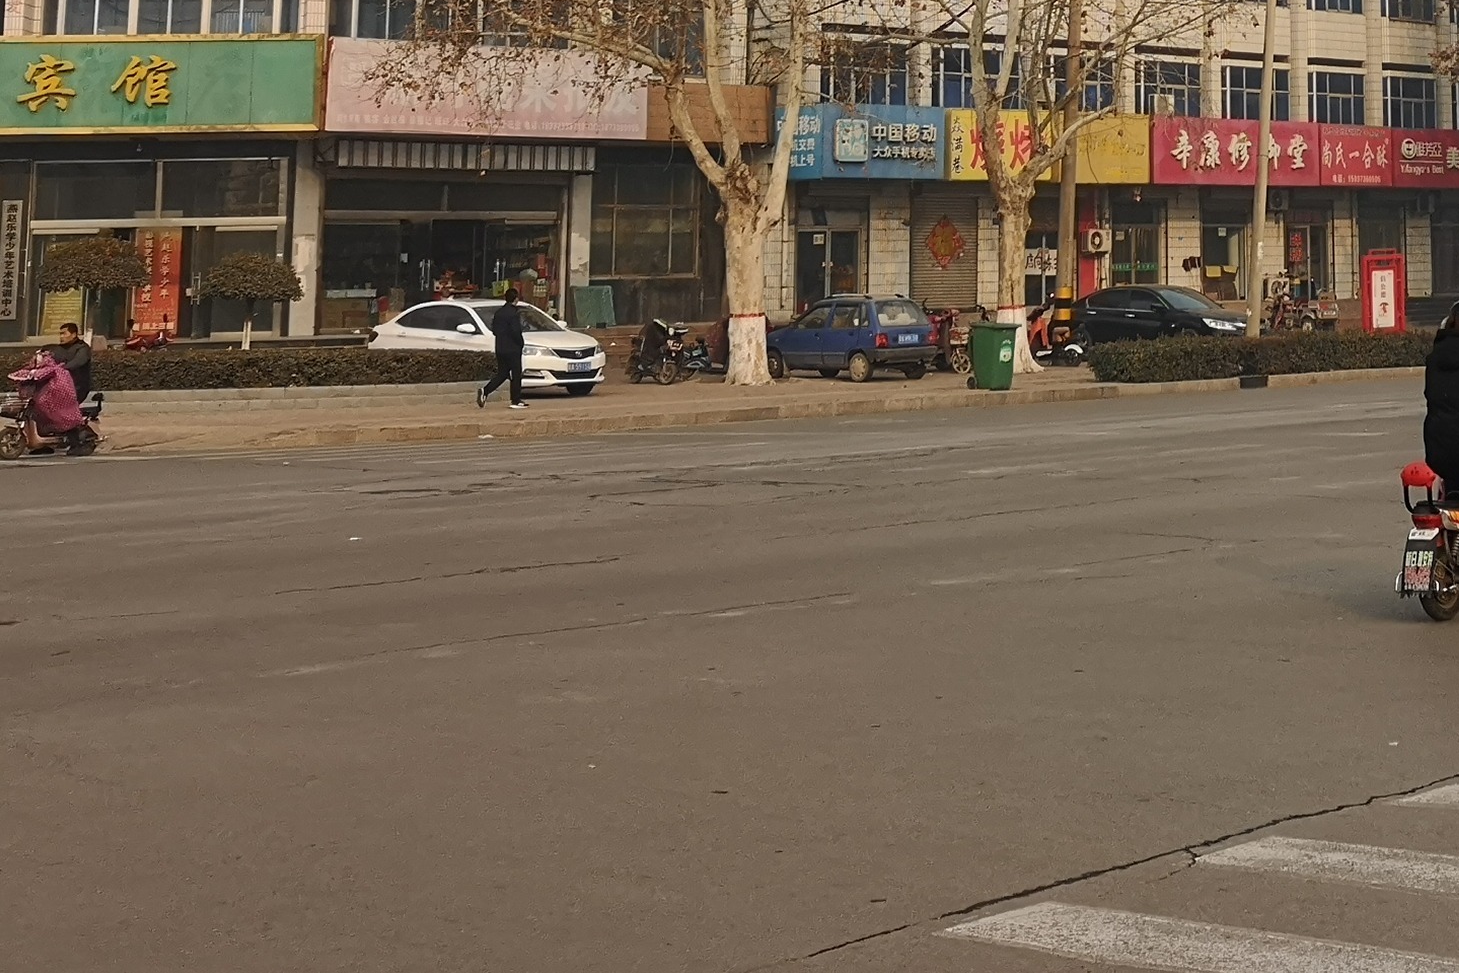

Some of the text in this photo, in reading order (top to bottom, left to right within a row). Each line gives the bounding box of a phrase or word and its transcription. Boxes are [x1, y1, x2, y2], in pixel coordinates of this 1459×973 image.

[16, 54, 177, 113] 宾馆
[872, 123, 937, 142] 中国移动
[0, 204, 18, 317] 燕赵乐学少年艺术培训中心
